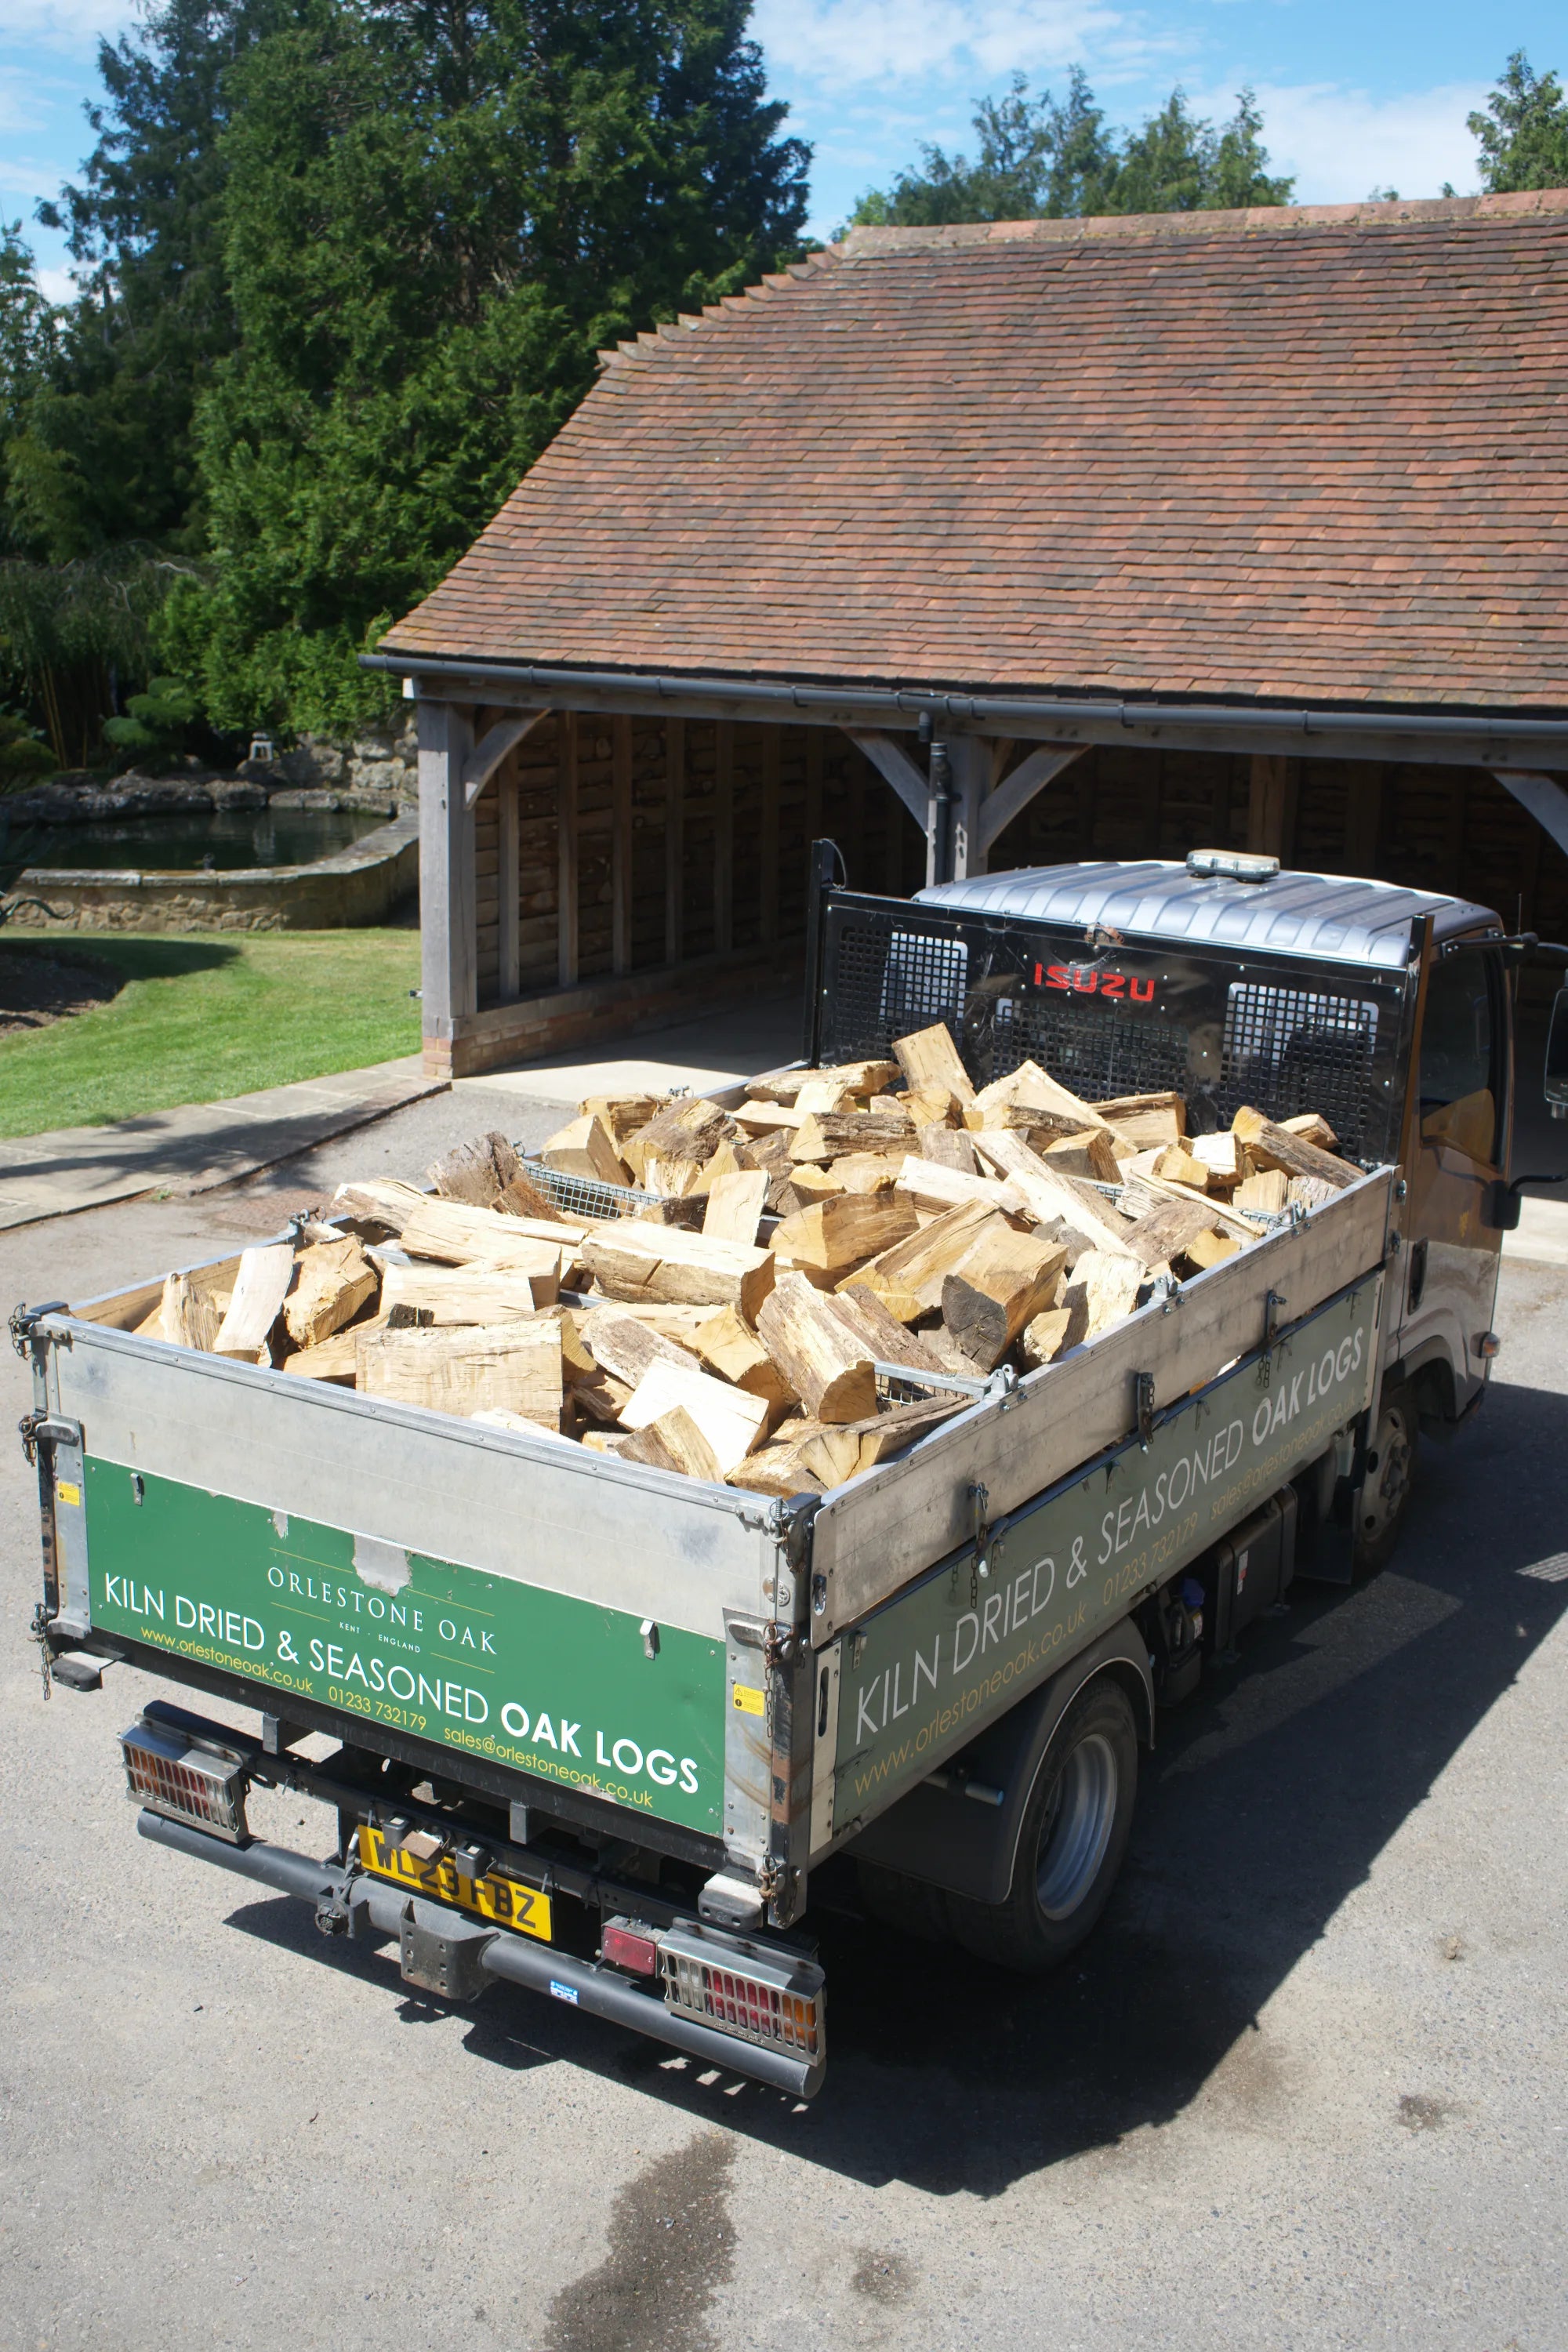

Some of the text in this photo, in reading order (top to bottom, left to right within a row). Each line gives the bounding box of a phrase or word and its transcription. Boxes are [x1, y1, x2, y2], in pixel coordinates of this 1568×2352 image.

[1034, 963, 1155, 1002] ISUZU
[855, 1327, 1363, 1746] KILN DRIED & SEASONED OAK LOGS
[267, 1566, 497, 1655] ORLESTONE OAK
[339, 1621, 421, 1653] KENT ENGLAND
[854, 1601, 1087, 1797] www.orlestoneoak.co.uk
[1103, 1552, 1148, 1606] 01233
[1150, 1512, 1198, 1569] 732179
[105, 1572, 699, 1794] KILN DRIED & SEASONED OAK LOGS
[140, 1626, 314, 1693] www.orlestoneoak.co.uk
[328, 1686, 371, 1713] 01233
[375, 1700, 426, 1731] 732179
